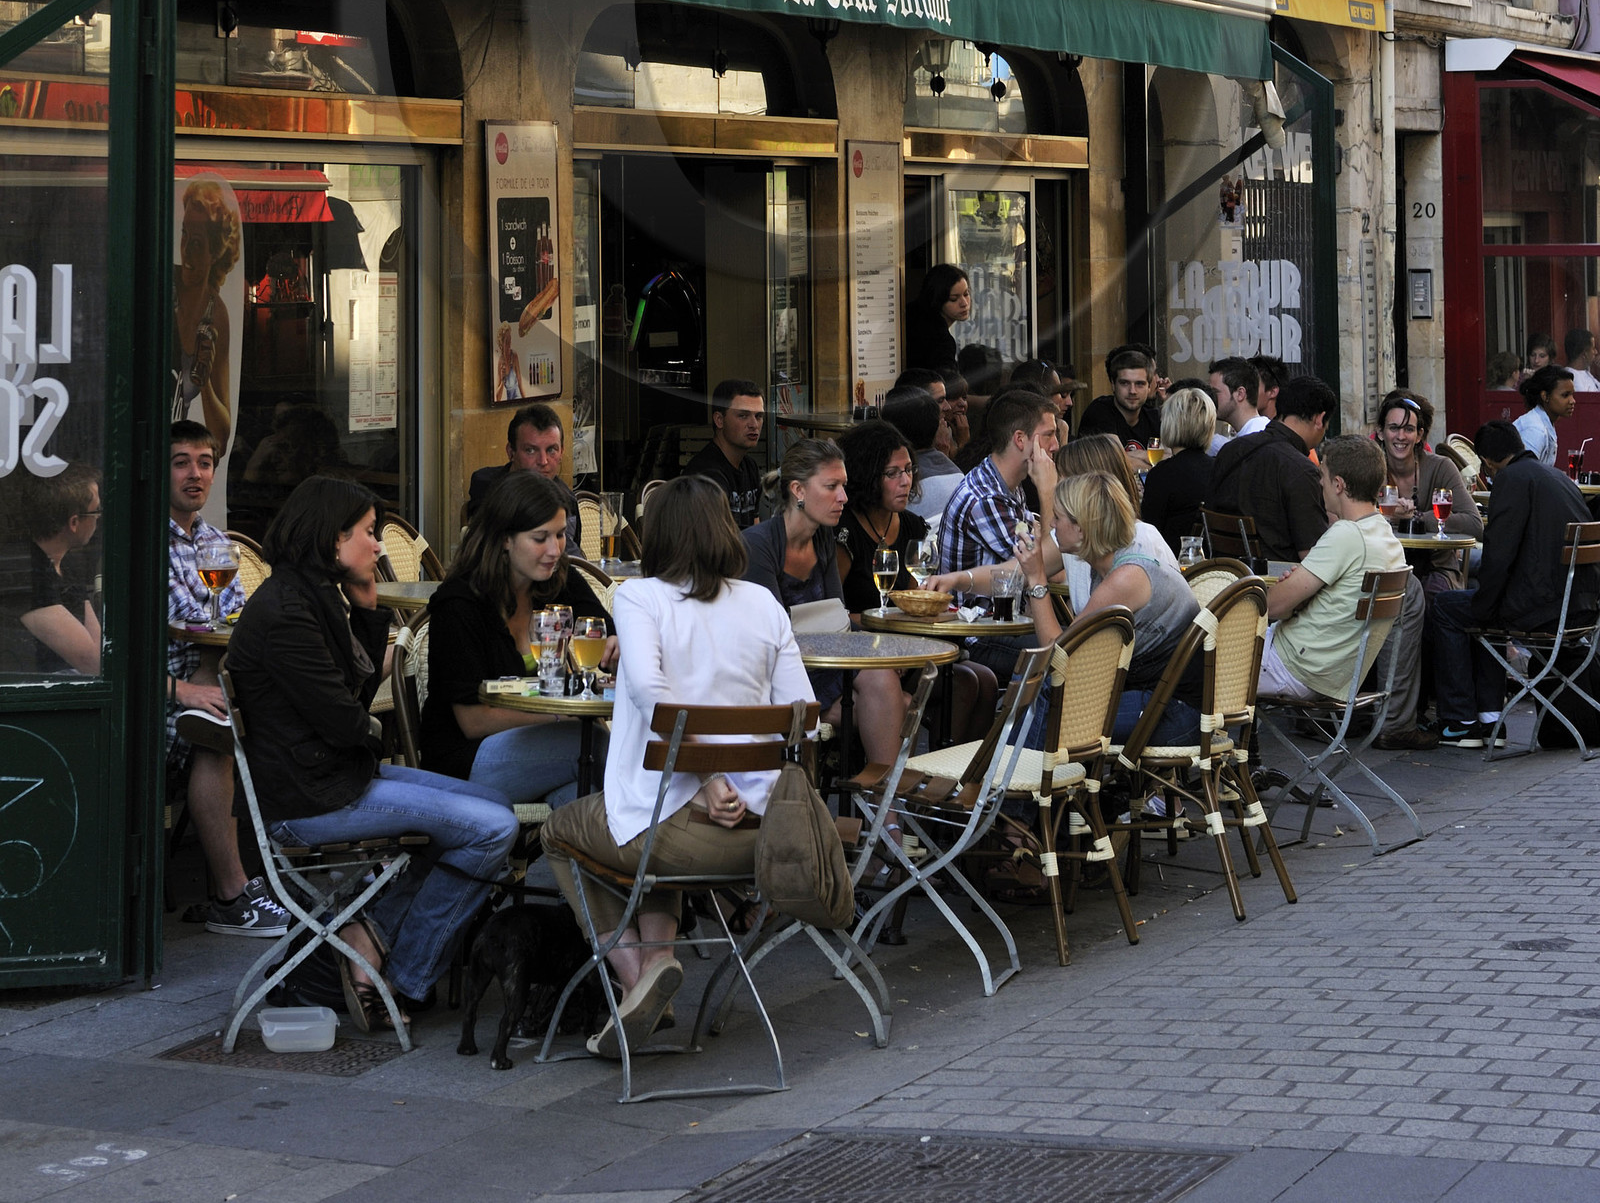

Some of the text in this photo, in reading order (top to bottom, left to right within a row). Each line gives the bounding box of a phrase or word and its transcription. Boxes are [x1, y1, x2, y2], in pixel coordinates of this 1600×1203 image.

[496, 177, 550, 190] FORMULE DE LA TOUR
[1412, 202, 1436, 219] 20
[504, 218, 527, 231] sandwich
[1361, 211, 1370, 234] 22
[506, 251, 525, 265] Boisson
[1168, 258, 1302, 309] LA TOUR
